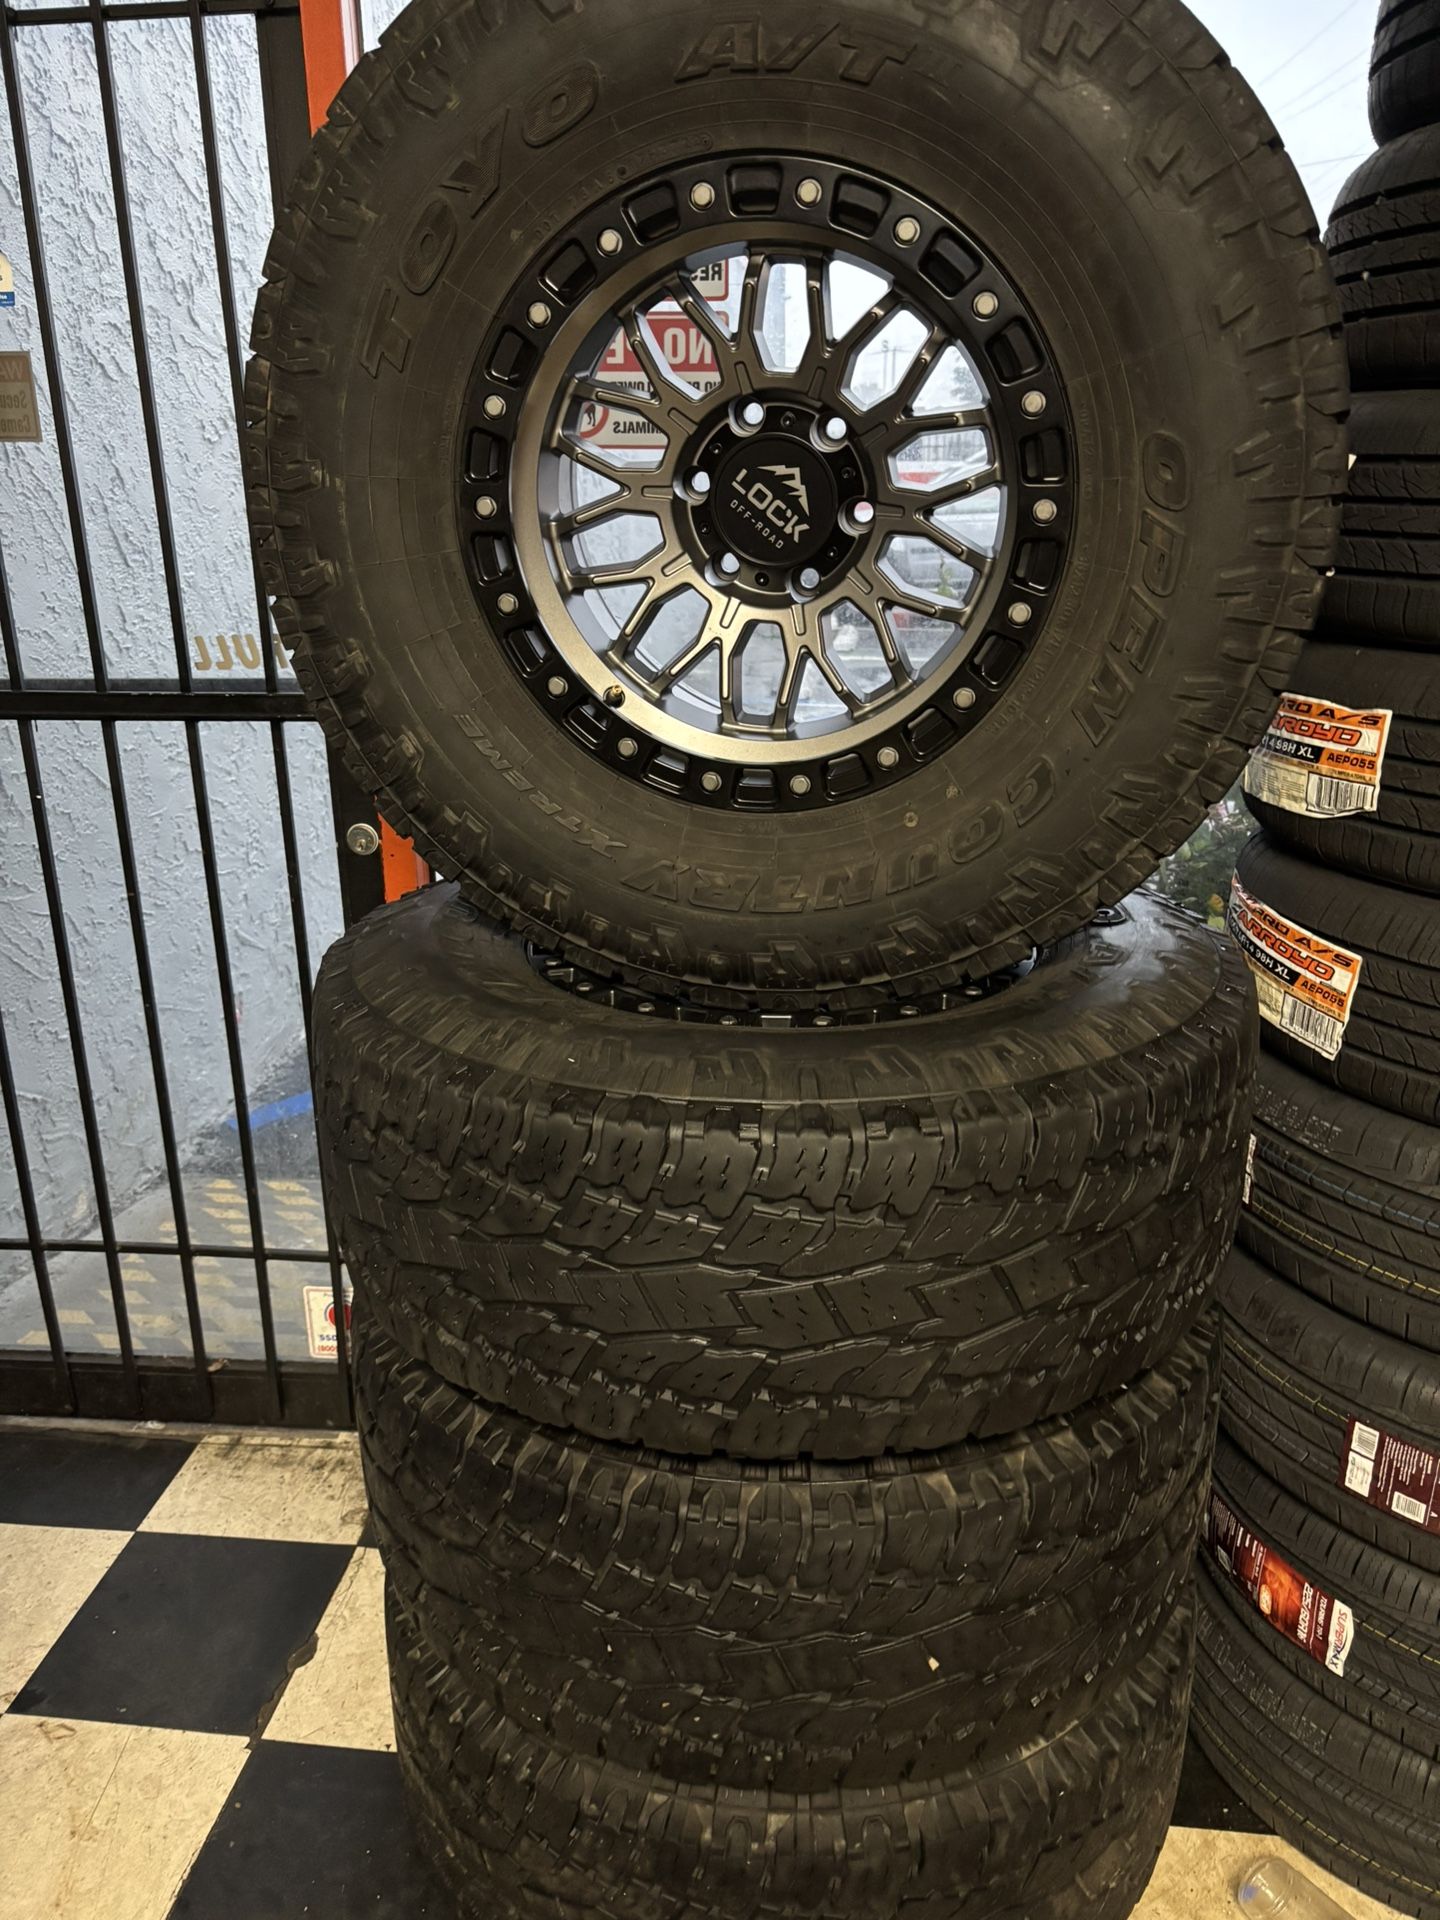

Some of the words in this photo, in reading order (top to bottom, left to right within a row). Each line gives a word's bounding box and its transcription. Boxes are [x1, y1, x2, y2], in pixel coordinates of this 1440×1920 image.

[358, 58, 599, 379] TOYO
[730, 499, 784, 549] OFF-ROAD
[731, 468, 810, 544] LOCK
[1071, 431, 1188, 748] OPEN
[1317, 707, 1382, 727] A/S
[1297, 745, 1315, 759] XL
[1326, 753, 1376, 770] AEP055
[453, 714, 628, 859] XTREME
[619, 755, 1057, 913] COUNTRY
[1255, 949, 1274, 968] 98H
[1274, 962, 1291, 980] XL
[1294, 936, 1354, 968] A/S
[1301, 980, 1345, 1008] AEP055
